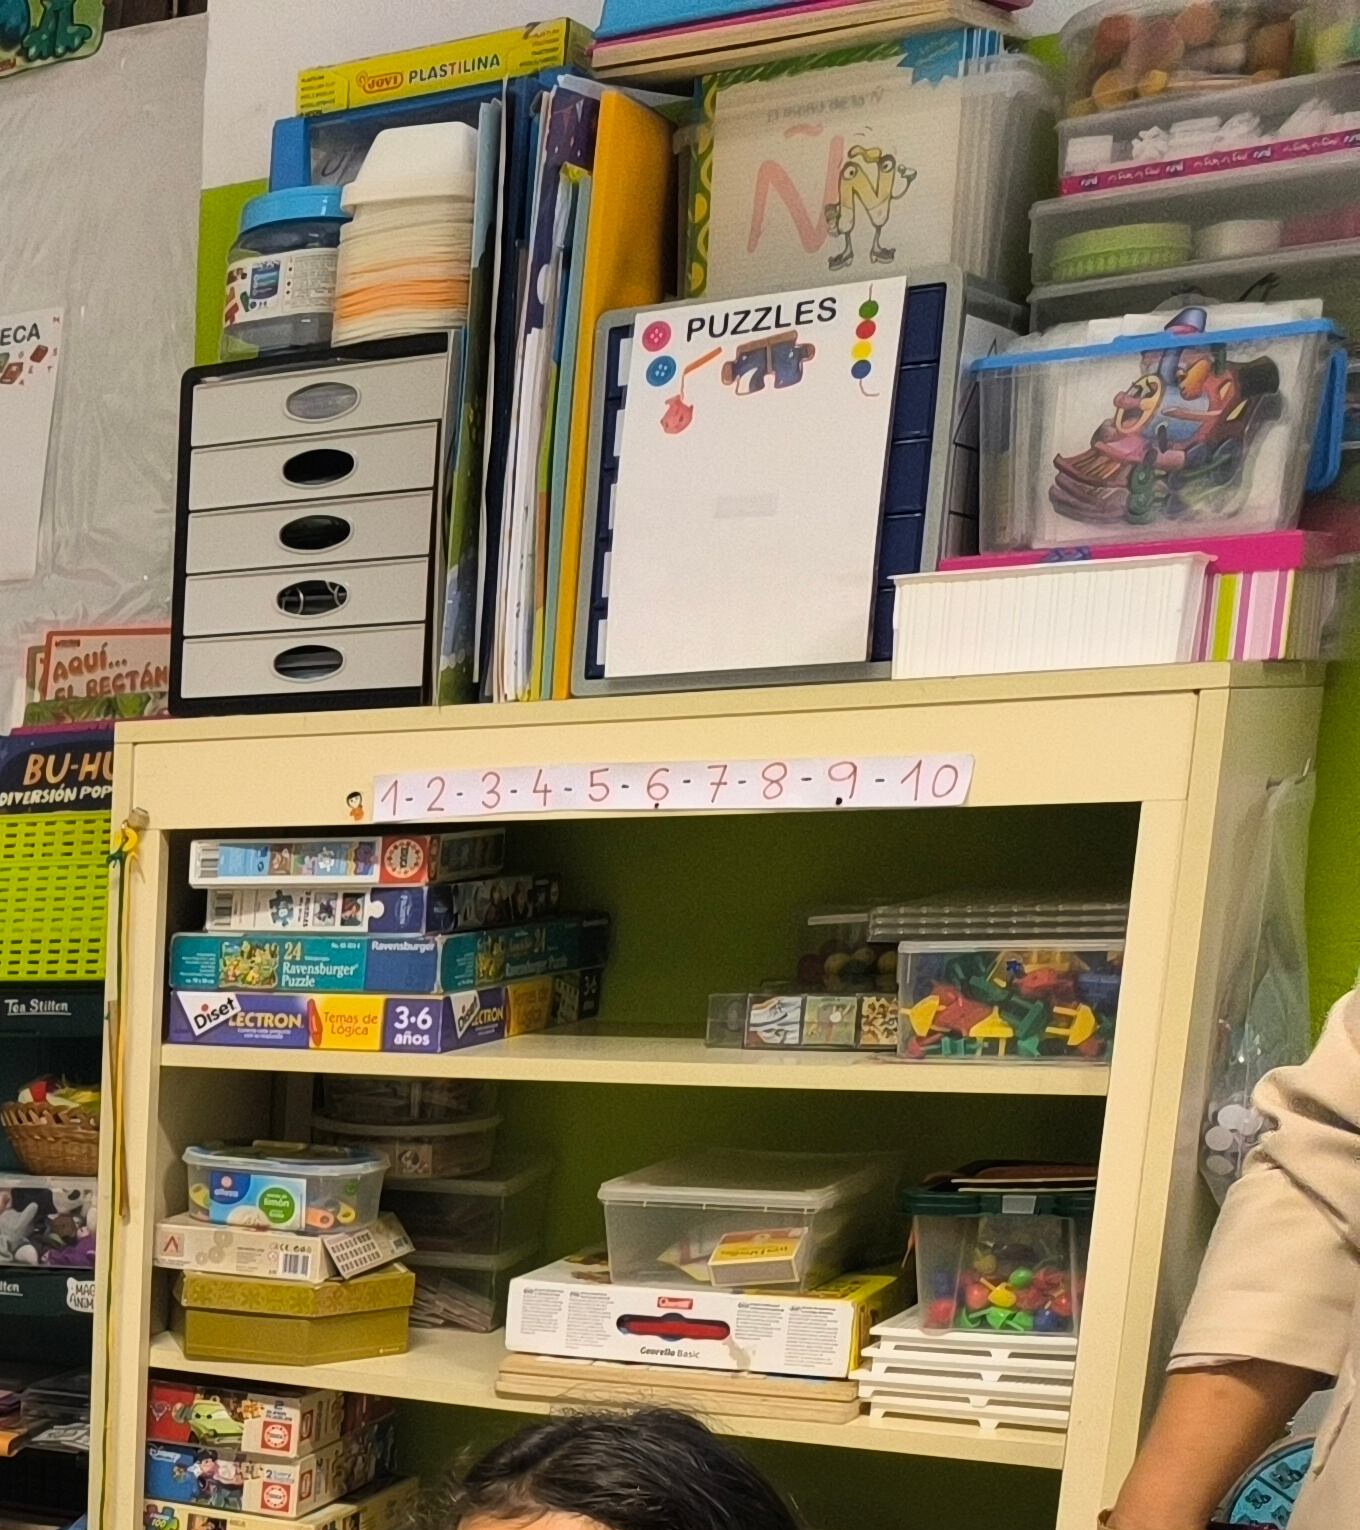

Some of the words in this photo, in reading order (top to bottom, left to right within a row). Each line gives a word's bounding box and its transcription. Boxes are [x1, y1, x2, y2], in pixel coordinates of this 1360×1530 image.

[367, 76, 399, 90] JOVI
[409, 53, 501, 84] PLASTILINA
[685, 297, 838, 343] PUZZLES
[52, 641, 128, 684] AQUÍ...
[283, 941, 303, 961] 24
[371, 940, 436, 954] Ravensburger
[281, 960, 360, 977] Ravensburger
[281, 975, 317, 988] Puzzle
[4, 999, 28, 1014] Tea
[193, 996, 238, 1030] Diset
[323, 1010, 359, 1025] Temas
[363, 1011, 379, 1025] de
[330, 1022, 369, 1037] Lógica
[393, 1030, 431, 1046] años
